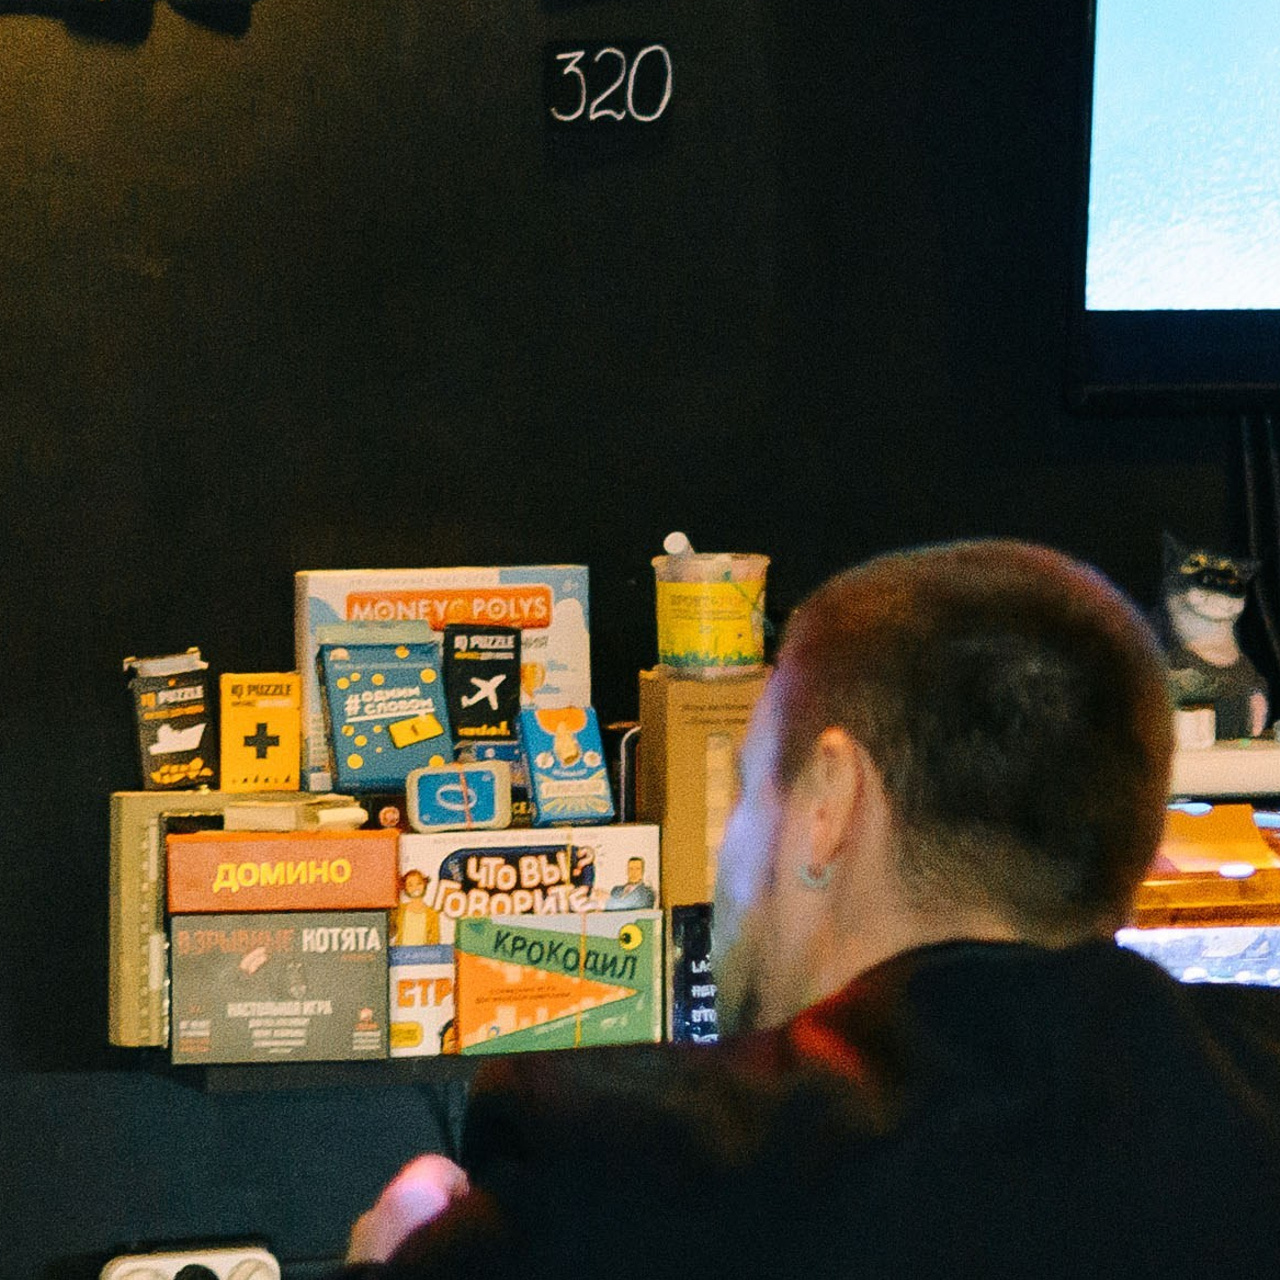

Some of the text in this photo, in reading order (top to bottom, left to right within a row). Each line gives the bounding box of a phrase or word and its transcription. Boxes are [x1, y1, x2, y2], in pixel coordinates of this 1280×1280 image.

[551, 44, 673, 122] 320
[350, 596, 548, 621] MONEY POLYS
[247, 683, 293, 697] PUZZLE
[212, 857, 354, 893] ДОМИНО
[302, 926, 382, 953] КОТЯТА
[493, 930, 639, 980] КРОКОДИЛ
